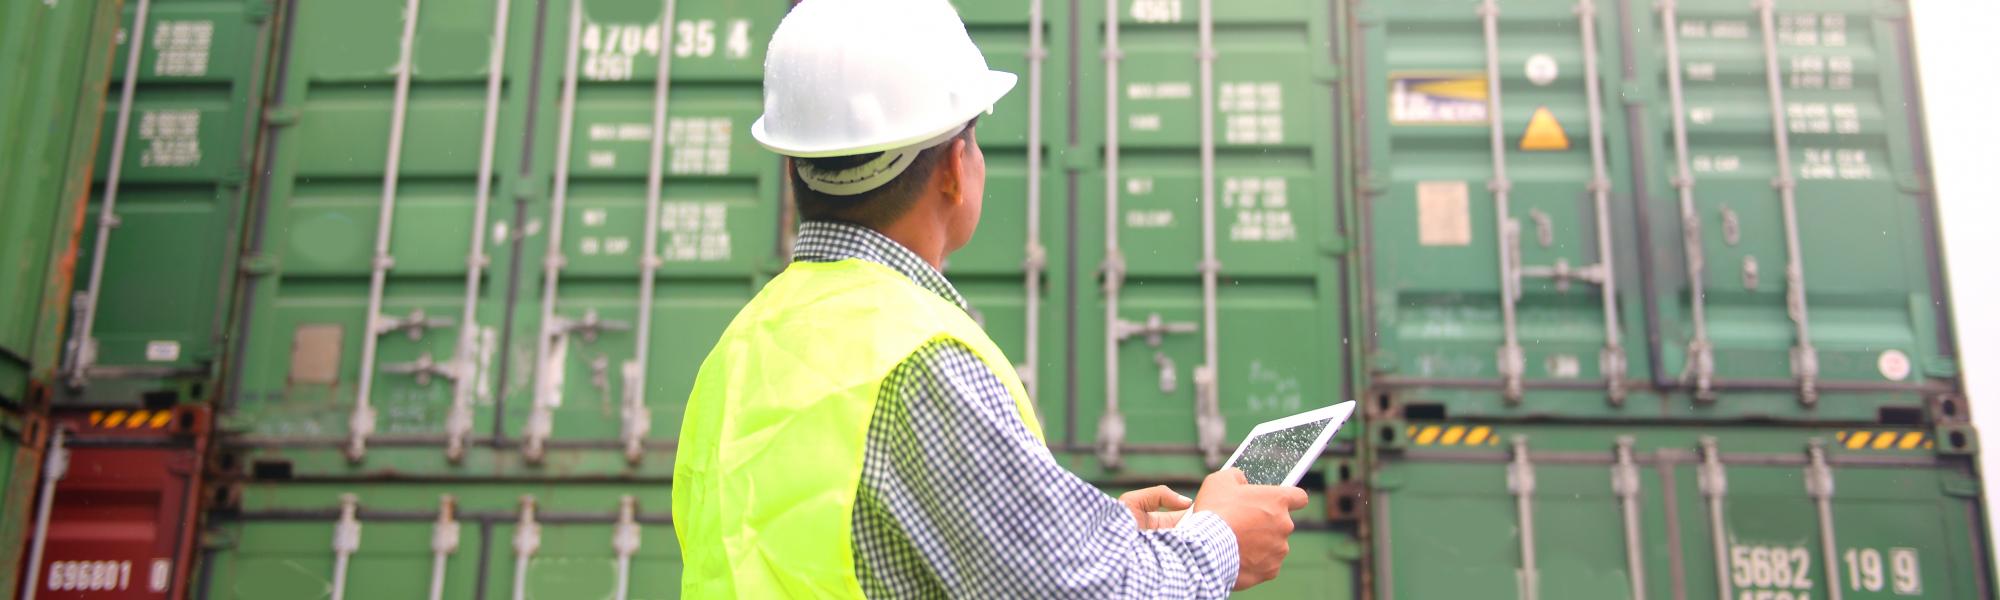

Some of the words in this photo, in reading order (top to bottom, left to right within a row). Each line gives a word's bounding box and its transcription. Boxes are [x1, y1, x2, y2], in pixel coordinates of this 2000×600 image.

[583, 24, 661, 56] 4704
[675, 20, 716, 57] 35
[728, 20, 750, 57] 4
[1731, 546, 1813, 589] 5682
[1843, 548, 1884, 592] 19
[1892, 548, 1917, 592] 9
